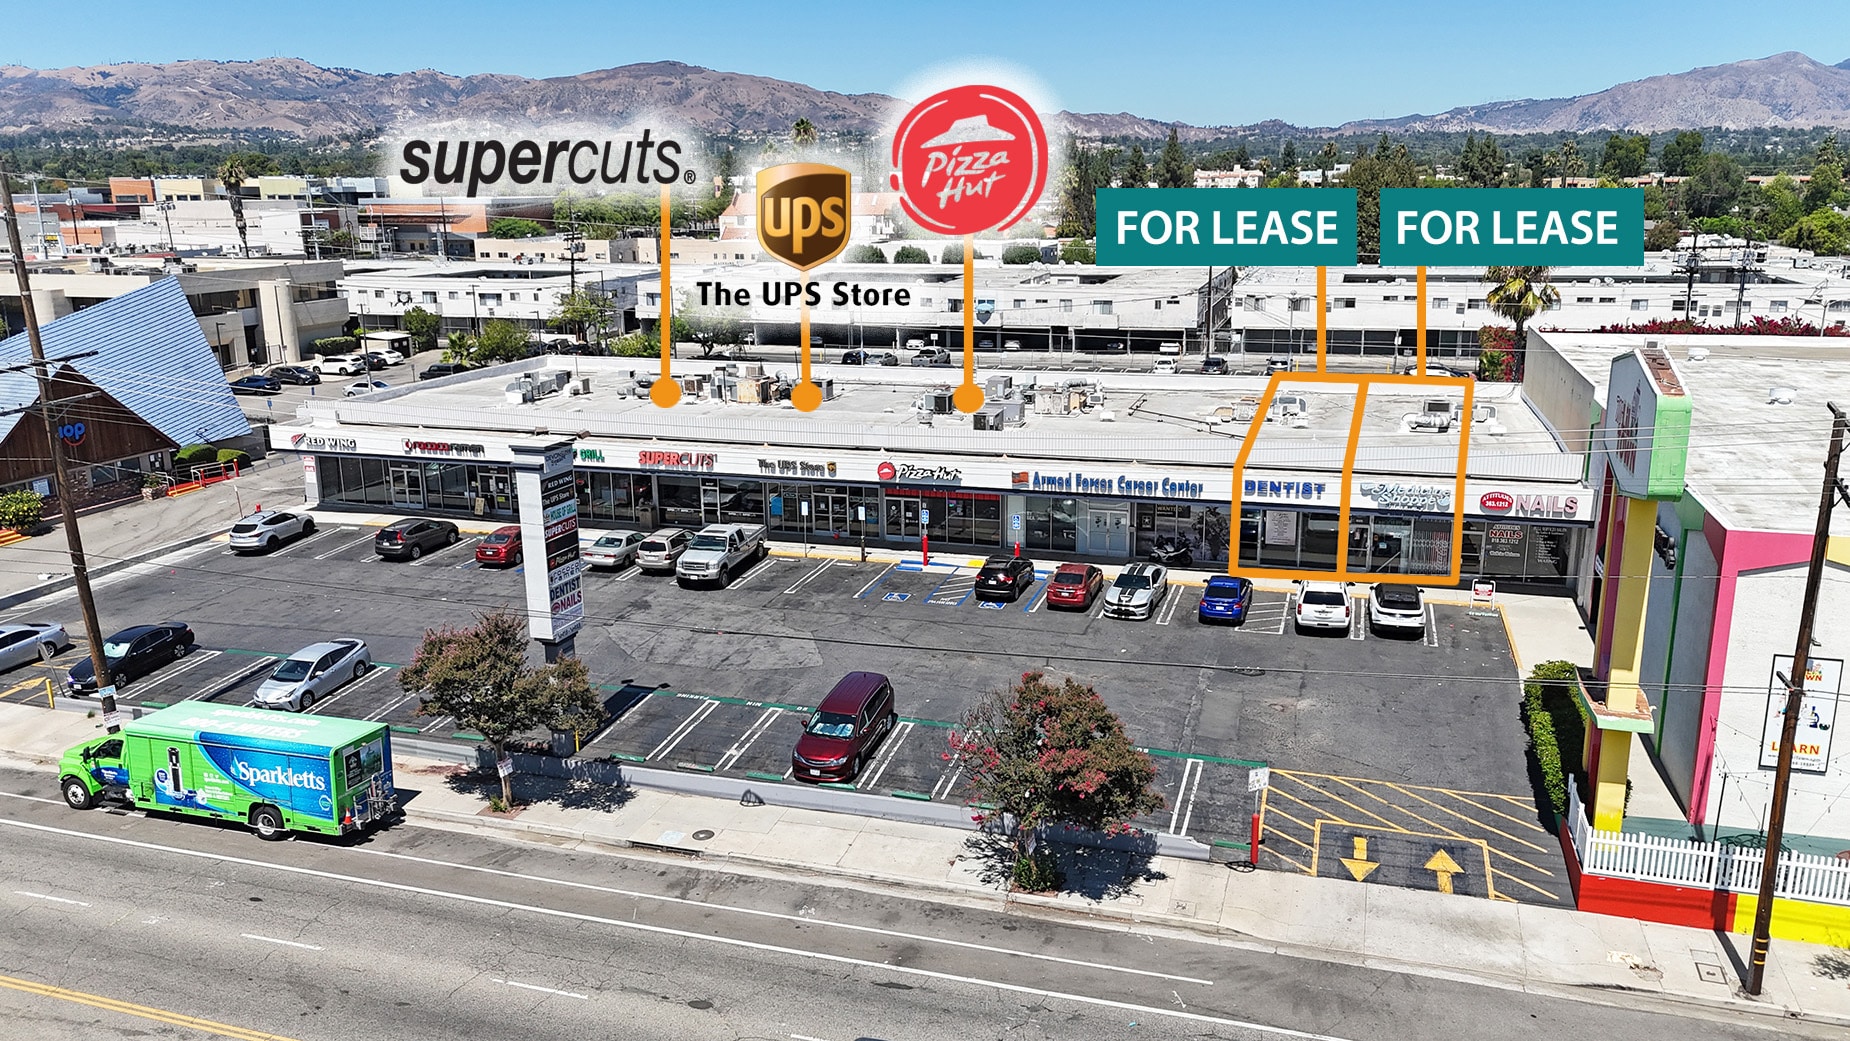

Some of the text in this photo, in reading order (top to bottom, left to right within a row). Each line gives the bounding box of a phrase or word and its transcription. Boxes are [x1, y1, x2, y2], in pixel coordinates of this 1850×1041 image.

[305, 437, 356, 449] RED WING
[639, 451, 714, 467] SUPERCUTS
[778, 460, 797, 470] UPS
[559, 475, 573, 485] WING
[896, 464, 962, 482] Pizza Hut
[1032, 471, 1203, 495] Armed Forces Career Center
[1244, 479, 1326, 495] DENTIST
[1378, 491, 1437, 507] Shoppe
[1516, 495, 1578, 513] NAILS
[544, 518, 577, 539] SUPERCUTS
[1489, 530, 1524, 540] NAILS
[550, 576, 580, 601] DENTIST
[560, 590, 582, 612] NAILS
[1771, 741, 1820, 755] LARN
[239, 761, 326, 791] Sparkletts
